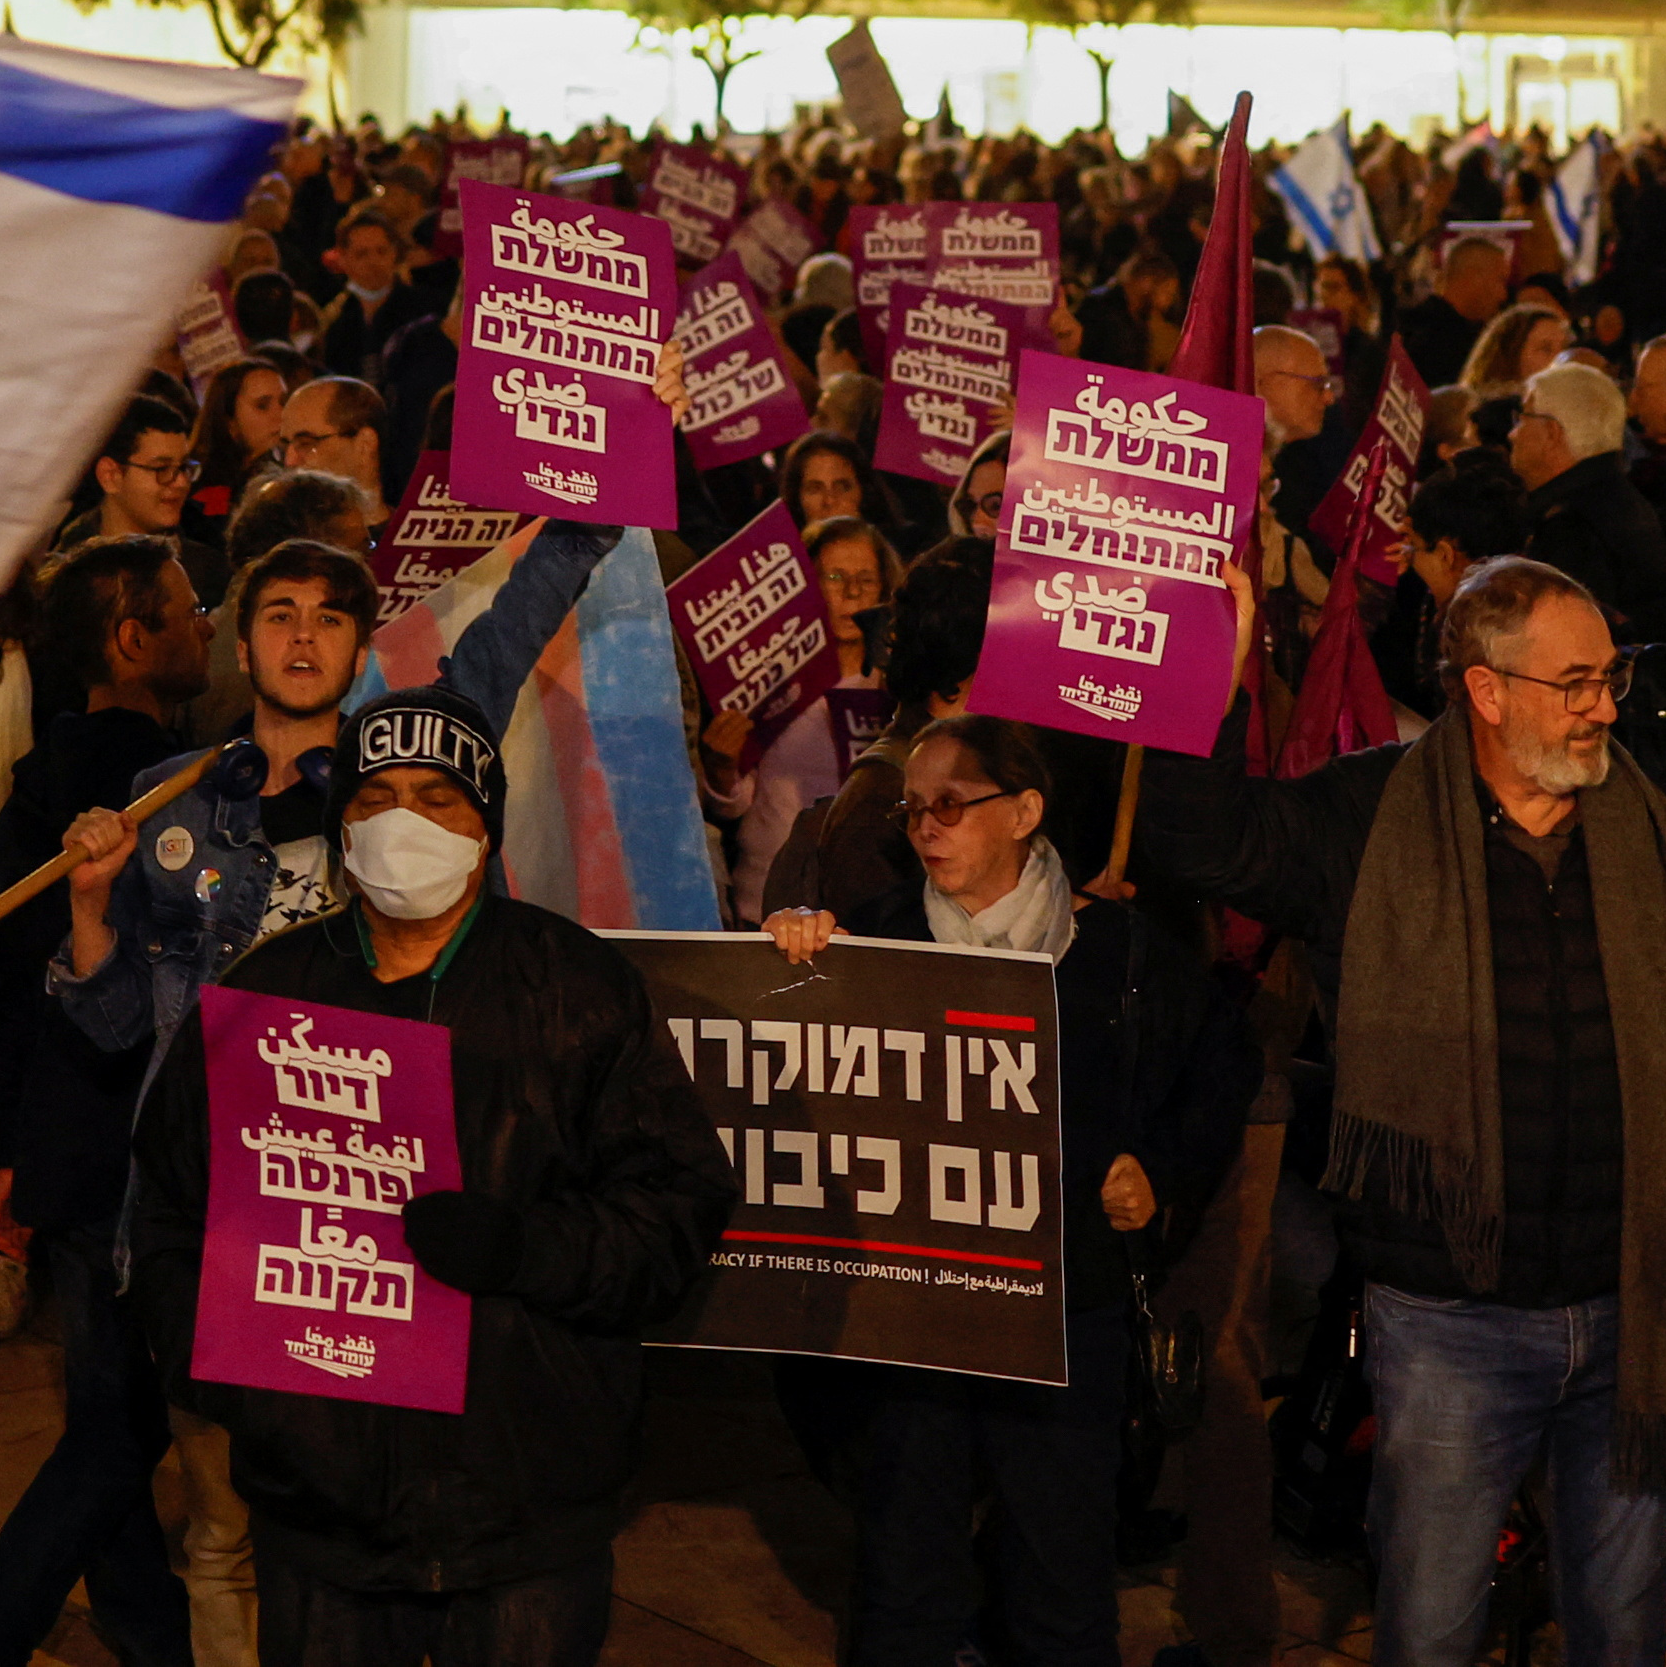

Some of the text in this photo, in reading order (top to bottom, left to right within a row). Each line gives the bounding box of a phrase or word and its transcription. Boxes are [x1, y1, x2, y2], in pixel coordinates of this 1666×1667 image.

[511, 198, 625, 250] حكومة
[947, 232, 1035, 252] ממשלת
[500, 233, 640, 288] ממשלת
[480, 283, 660, 340] المستوطنين
[716, 306, 744, 333] זה
[912, 314, 1002, 349] ממשלת
[480, 313, 655, 377] המתנחלים
[492, 367, 587, 414] ضدي
[684, 368, 774, 425] של כולנ
[1075, 373, 1209, 440] حكومة
[525, 401, 597, 443] נגדי
[925, 412, 969, 438] נגדי
[1053, 420, 1219, 482] ממשלת
[522, 471, 599, 496] עומדים ביחד
[1022, 477, 1235, 540] المستوطنين
[401, 518, 512, 541] זה הבית
[1019, 514, 1226, 579] המתנחלים
[739, 541, 793, 585] هذا
[701, 567, 798, 655] זה הבית
[1034, 571, 1149, 622] ضدي
[787, 624, 818, 667] של
[1073, 608, 1157, 654] נגדי
[1058, 685, 1141, 714] עומדים ביחד
[363, 714, 489, 789] GUILTY
[283, 1065, 368, 1111] דיור
[945, 1034, 1041, 1123] אין
[240, 1111, 426, 1173] لقمة عيش
[267, 1152, 408, 1205] פרנסה
[716, 1127, 1041, 1232] עם כיבו
[263, 1256, 407, 1319] תקווה
[749, 1254, 765, 1268] IF
[766, 1255, 814, 1271] THERE
[817, 1259, 831, 1273] IS
[833, 1260, 922, 1283] OCCUPATION
[284, 1339, 375, 1368] עומדים ביחד
